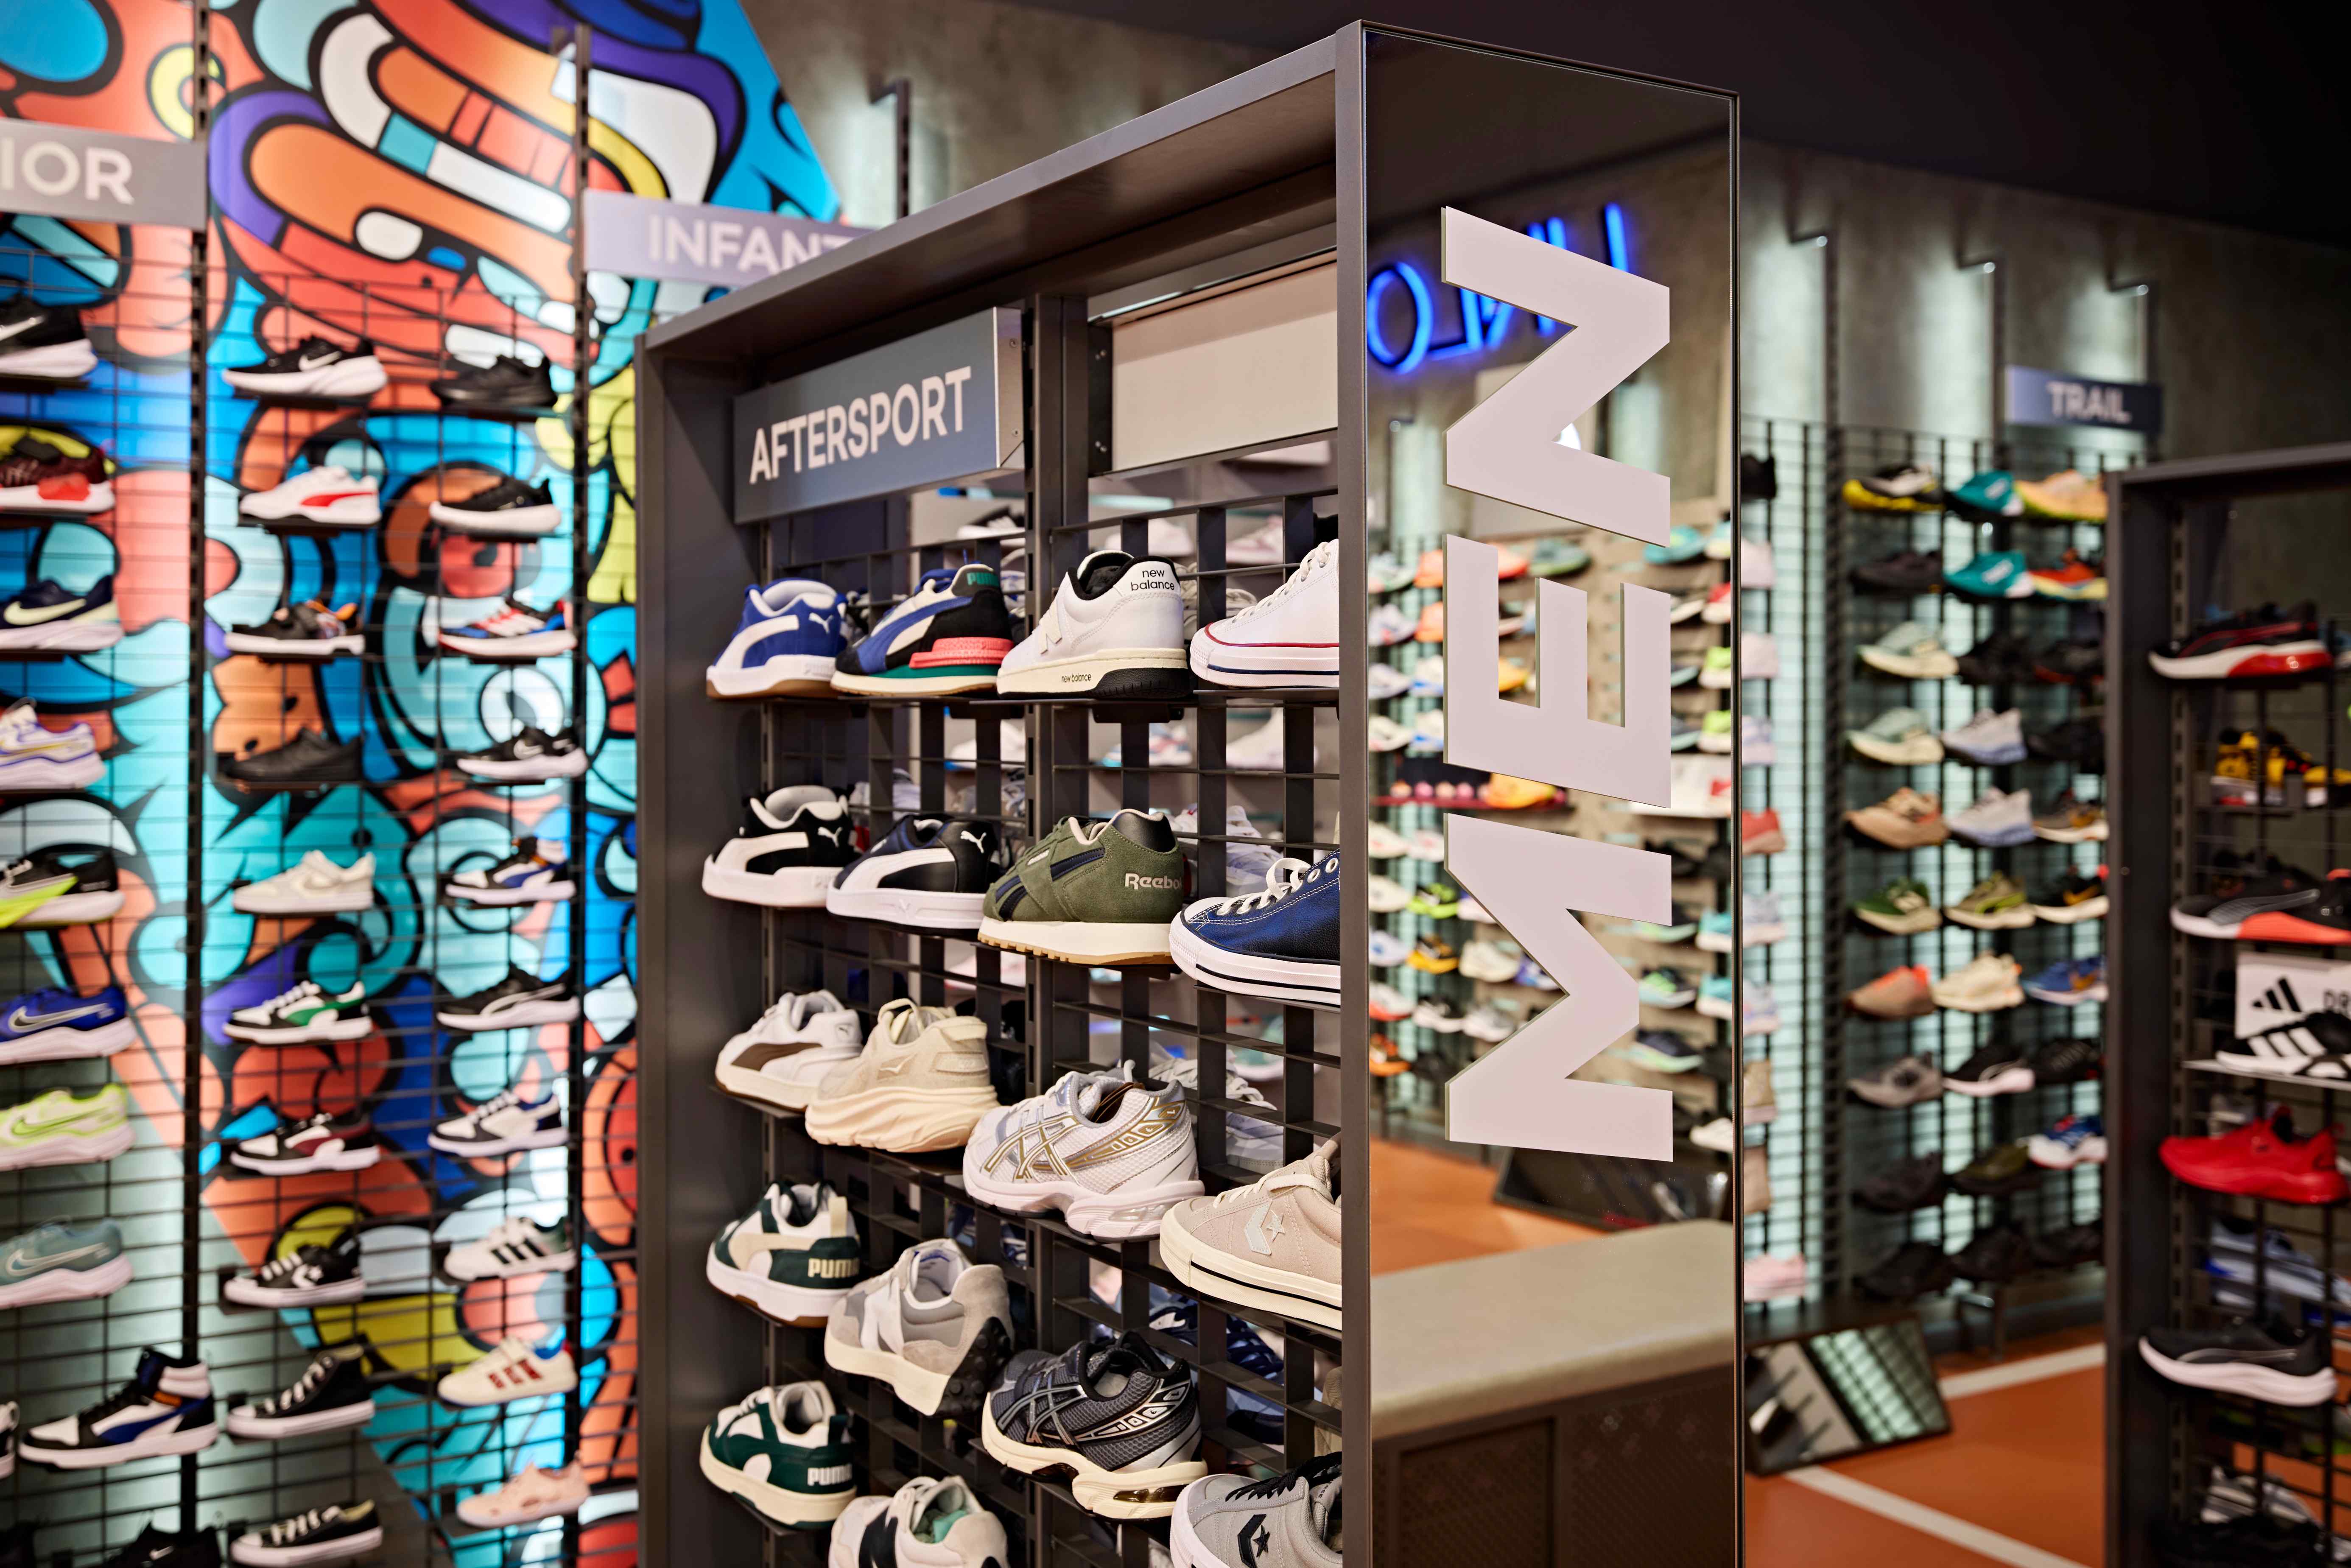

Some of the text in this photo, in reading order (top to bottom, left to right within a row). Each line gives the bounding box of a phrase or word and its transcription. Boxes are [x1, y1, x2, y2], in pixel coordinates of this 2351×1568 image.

[2045, 381, 2133, 424] TRAIL
[749, 366, 971, 484] AFTERSPORT
[1131, 579, 1174, 591] balance
[1142, 570, 1164, 578] new
[1071, 673, 1092, 682] balance
[1441, 206, 1673, 1162] MEN
